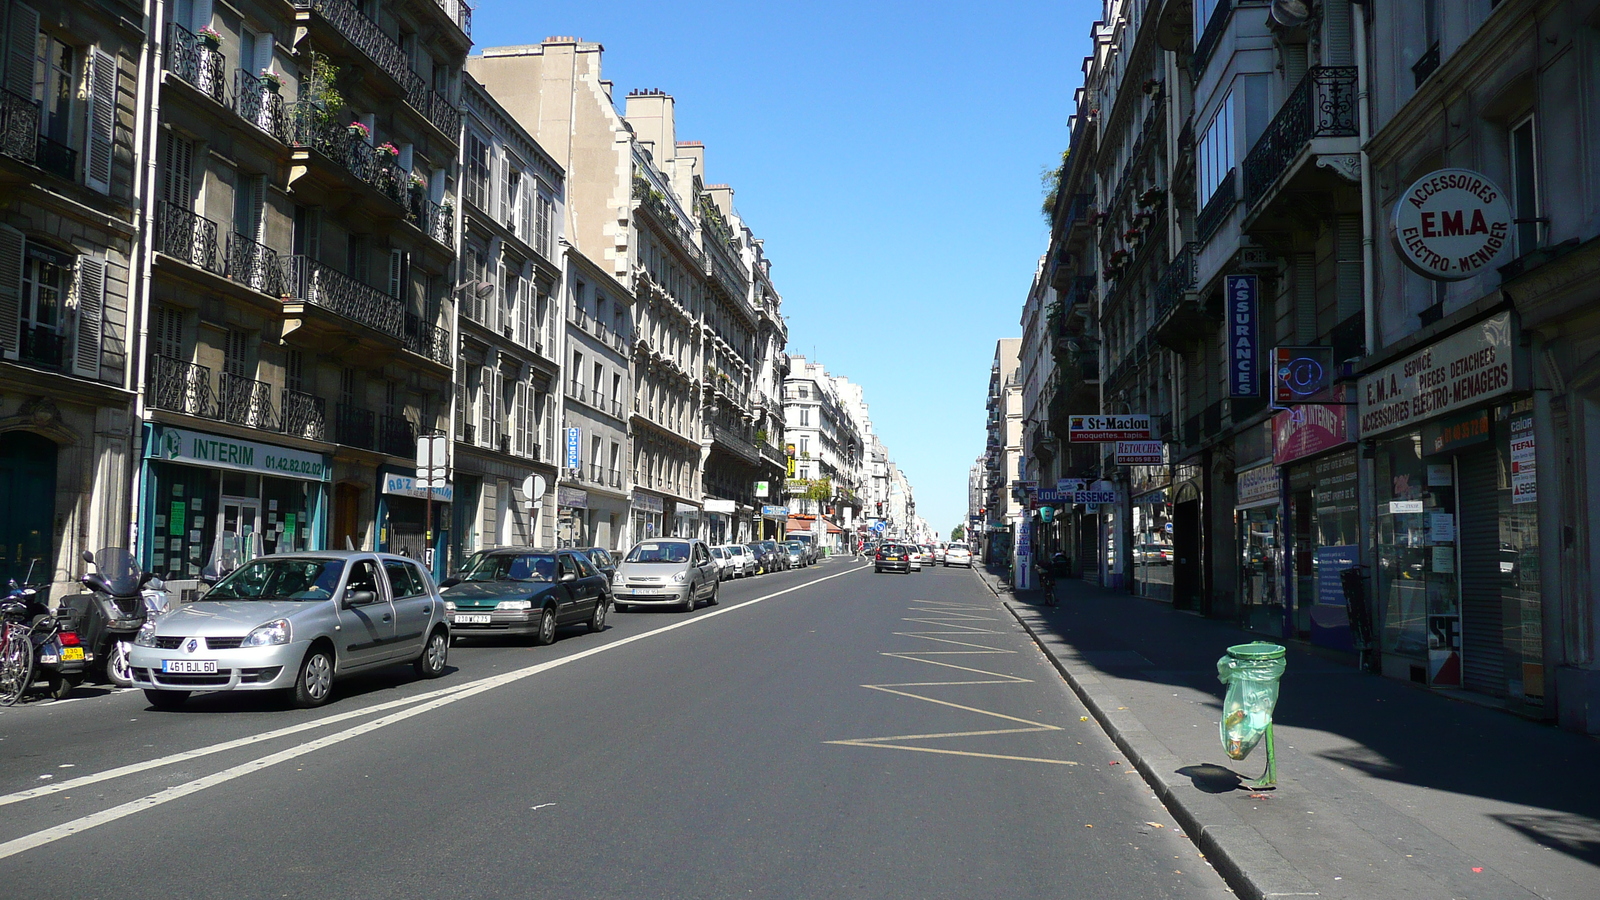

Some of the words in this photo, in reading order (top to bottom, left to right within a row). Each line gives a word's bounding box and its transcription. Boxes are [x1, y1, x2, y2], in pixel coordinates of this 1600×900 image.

[1409, 174, 1497, 209] ACCESSOIRES
[1420, 209, 1489, 237] E.M.A
[1235, 279, 1252, 395] ASSURANCES
[1404, 352, 1432, 378] SERVICE
[1420, 366, 1447, 391] PIECES
[1450, 345, 1497, 379] DETACHEES
[1087, 416, 1149, 430] St-Maclou
[1361, 400, 1410, 434] ACCESSOIRES
[193, 438, 254, 466] INTERIM
[265, 455, 321, 477] 01.42.82.02.02
[1117, 442, 1161, 454] RETOUCHES
[1511, 440, 1536, 452] TEFAL
[388, 478, 412, 491] AB'Z
[1075, 491, 1115, 503] ESSENCE
[170, 662, 184, 672] 461
[187, 662, 202, 672] BJL
[204, 662, 215, 672] 60
